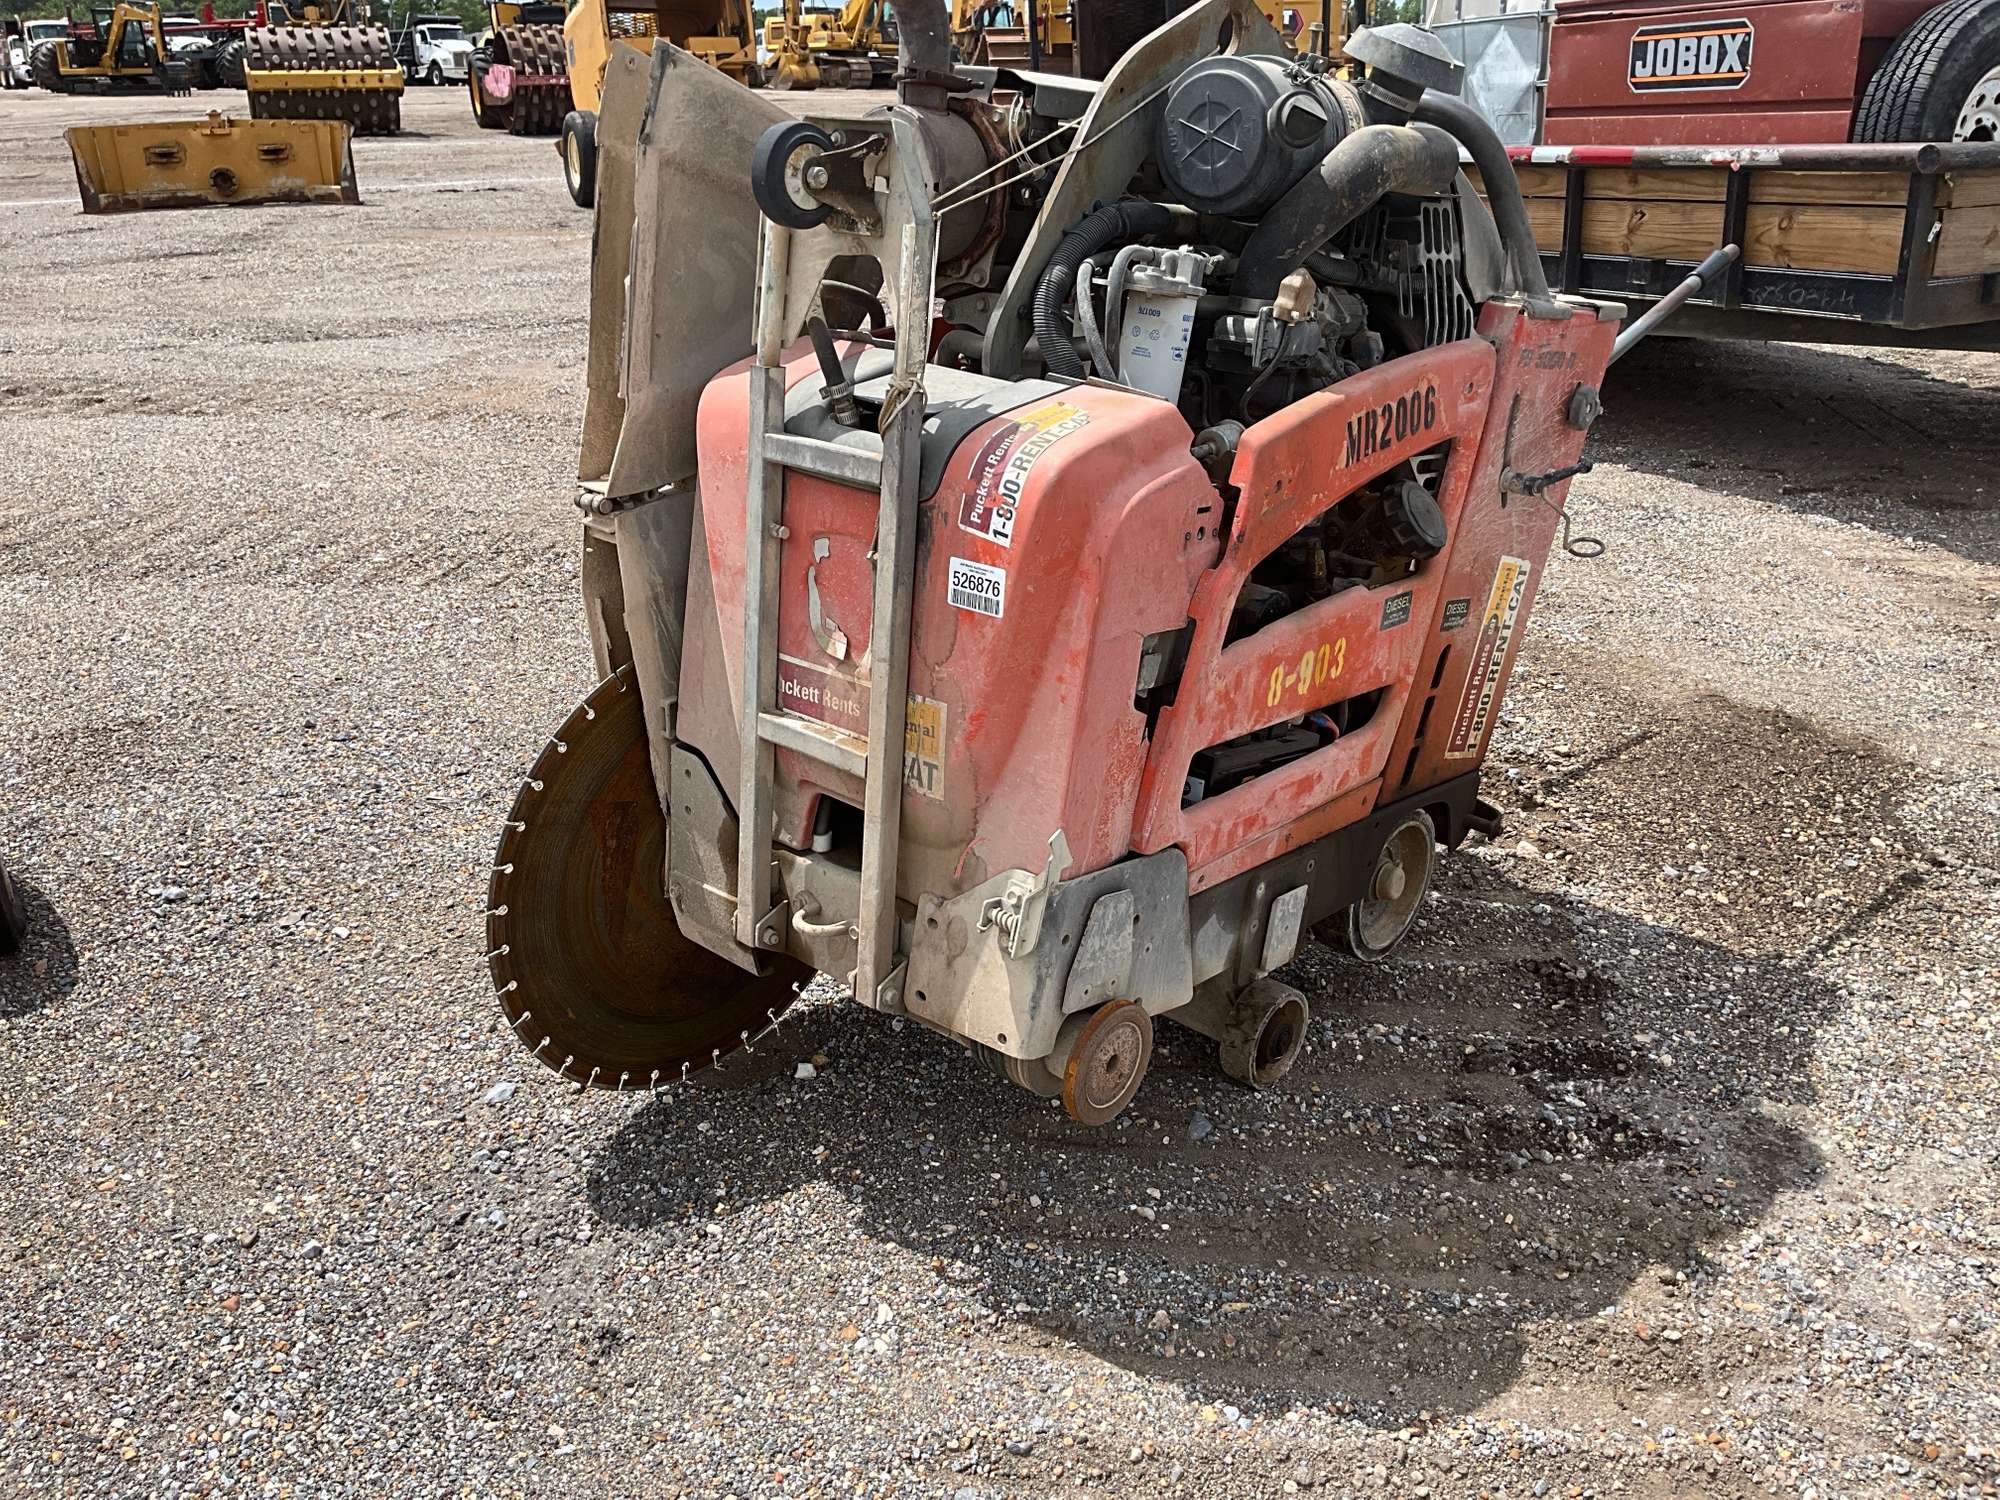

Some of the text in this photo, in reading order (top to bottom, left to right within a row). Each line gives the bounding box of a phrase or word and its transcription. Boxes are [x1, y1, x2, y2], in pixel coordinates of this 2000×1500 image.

[1634, 32, 1746, 78] JOBOX
[1345, 384, 1436, 468] MR2006
[970, 466, 995, 525] Puckett
[952, 570, 1001, 598] 526876
[1446, 602, 1468, 615] DIESEL
[1467, 565, 1528, 752] 1-800-RENT-CAT
[822, 688, 861, 718] Rents
[1455, 643, 1492, 746] Puckett Rents
